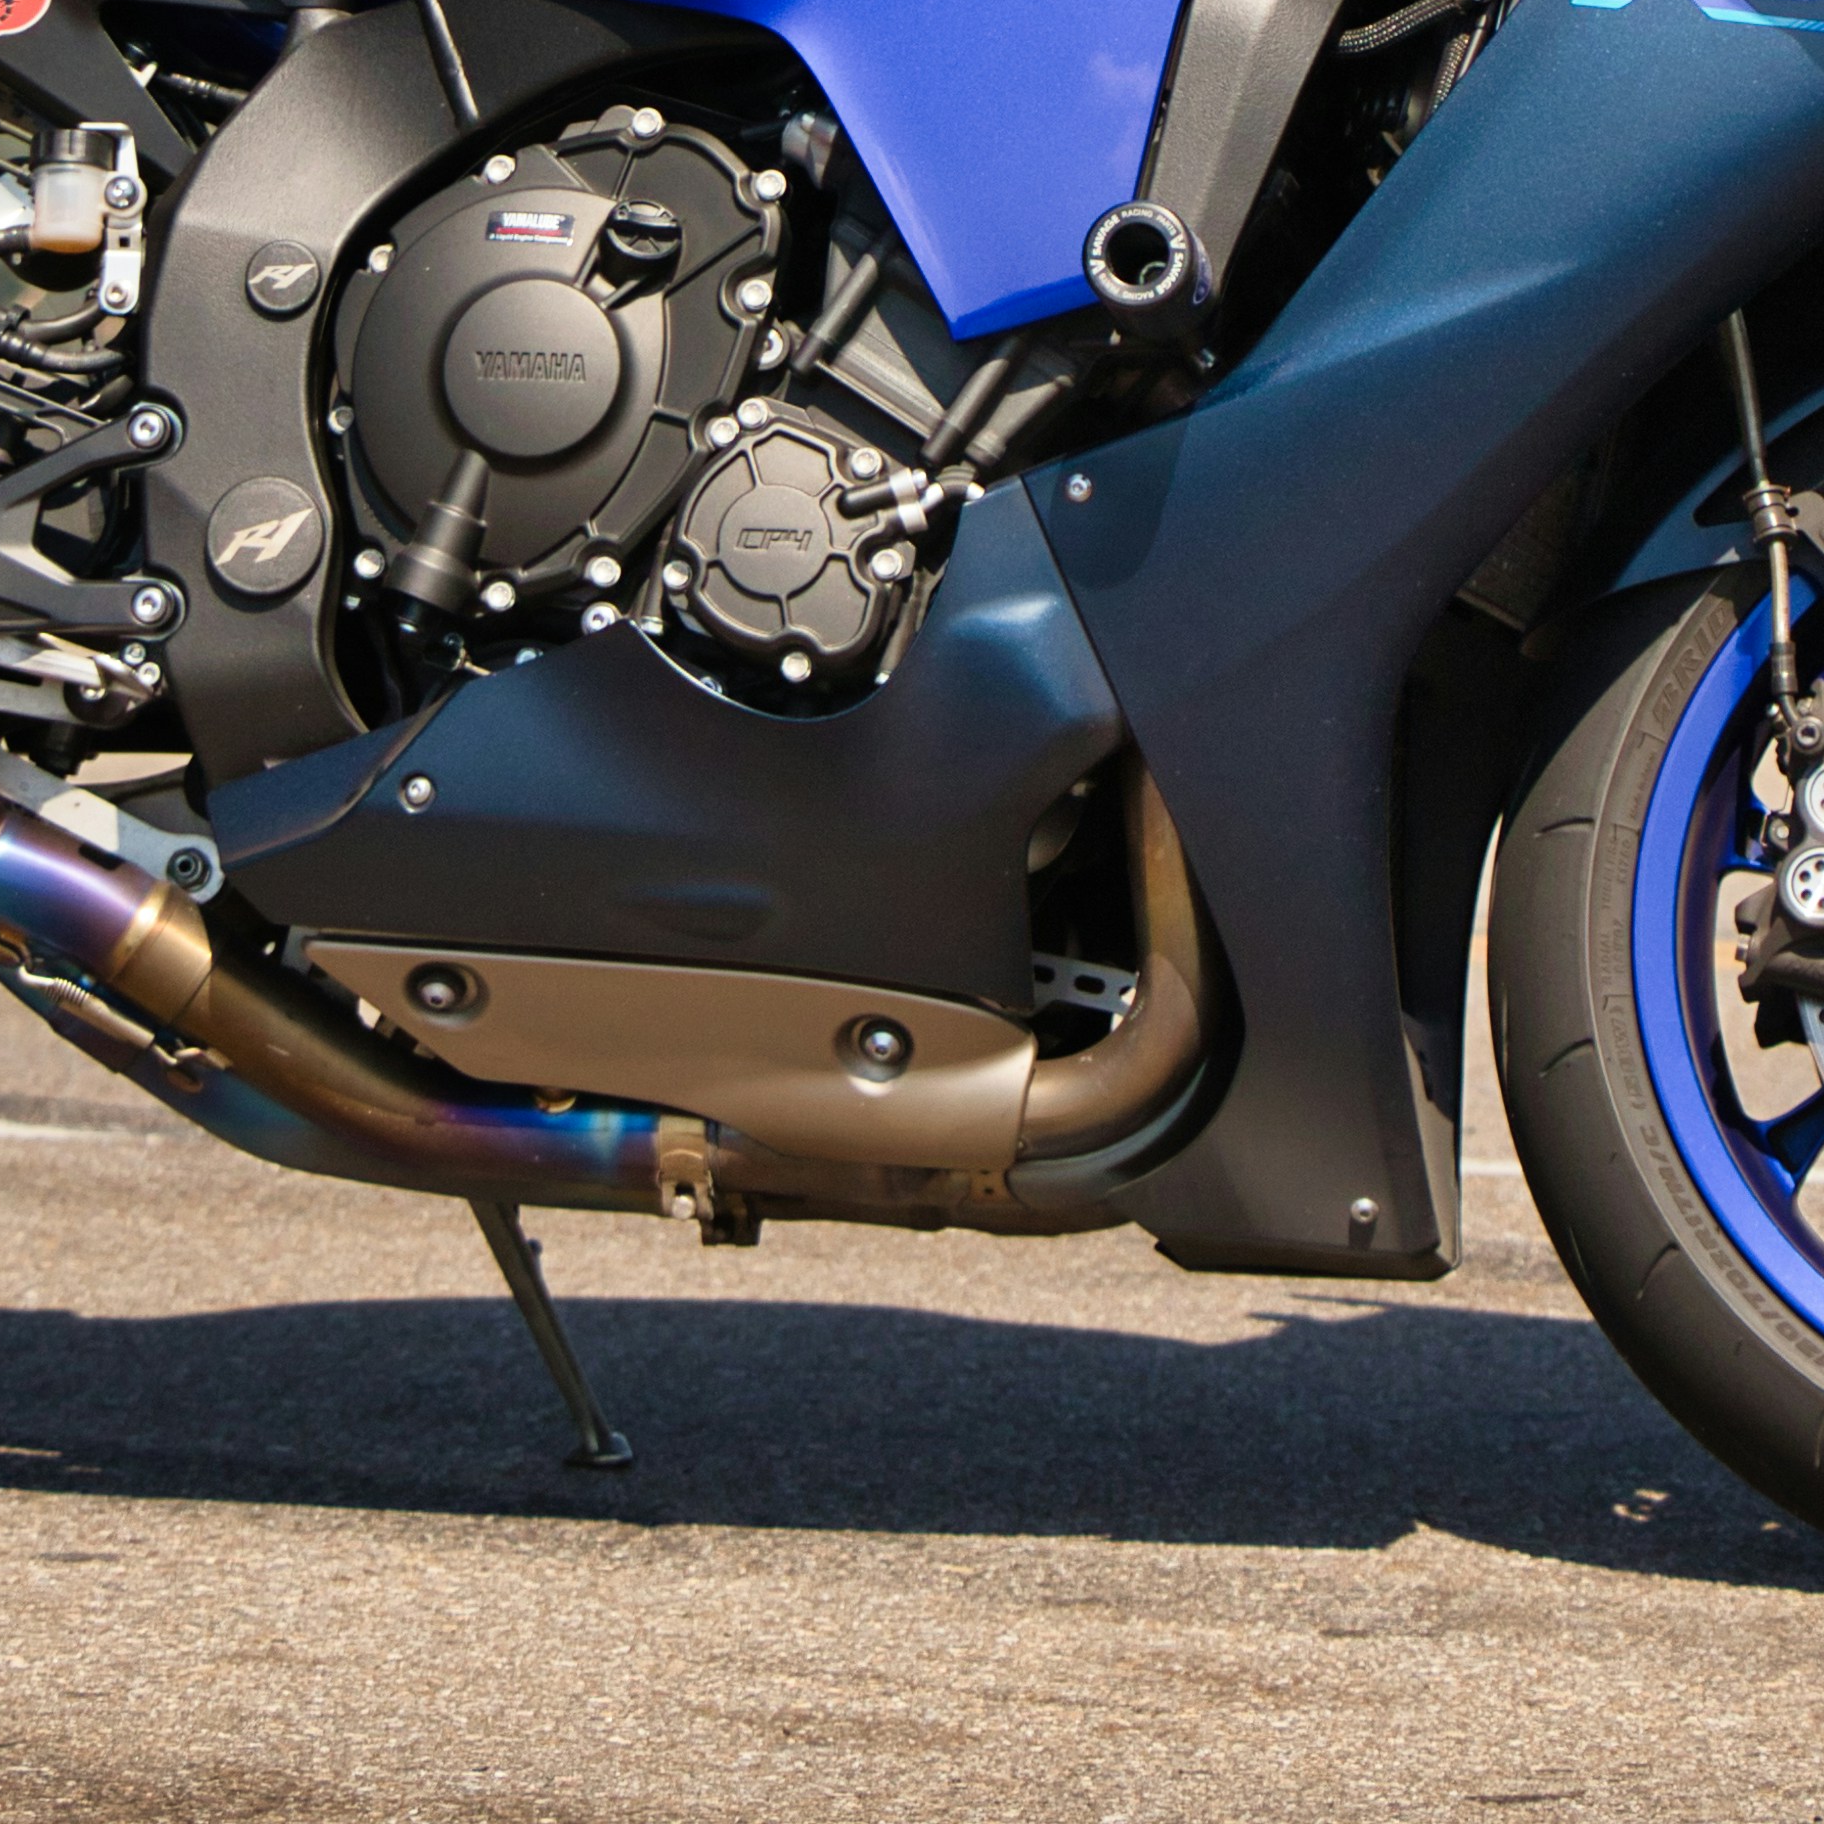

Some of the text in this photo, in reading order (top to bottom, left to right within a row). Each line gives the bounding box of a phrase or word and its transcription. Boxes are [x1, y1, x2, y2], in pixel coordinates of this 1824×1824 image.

[502, 212, 561, 230] YAMALUBE
[1091, 213, 1121, 256] SAVAGE
[1121, 208, 1154, 218] RACING
[1155, 252, 1184, 295] SAVAGE
[475, 350, 587, 383] YAMAHA
[733, 527, 814, 552] CP4
